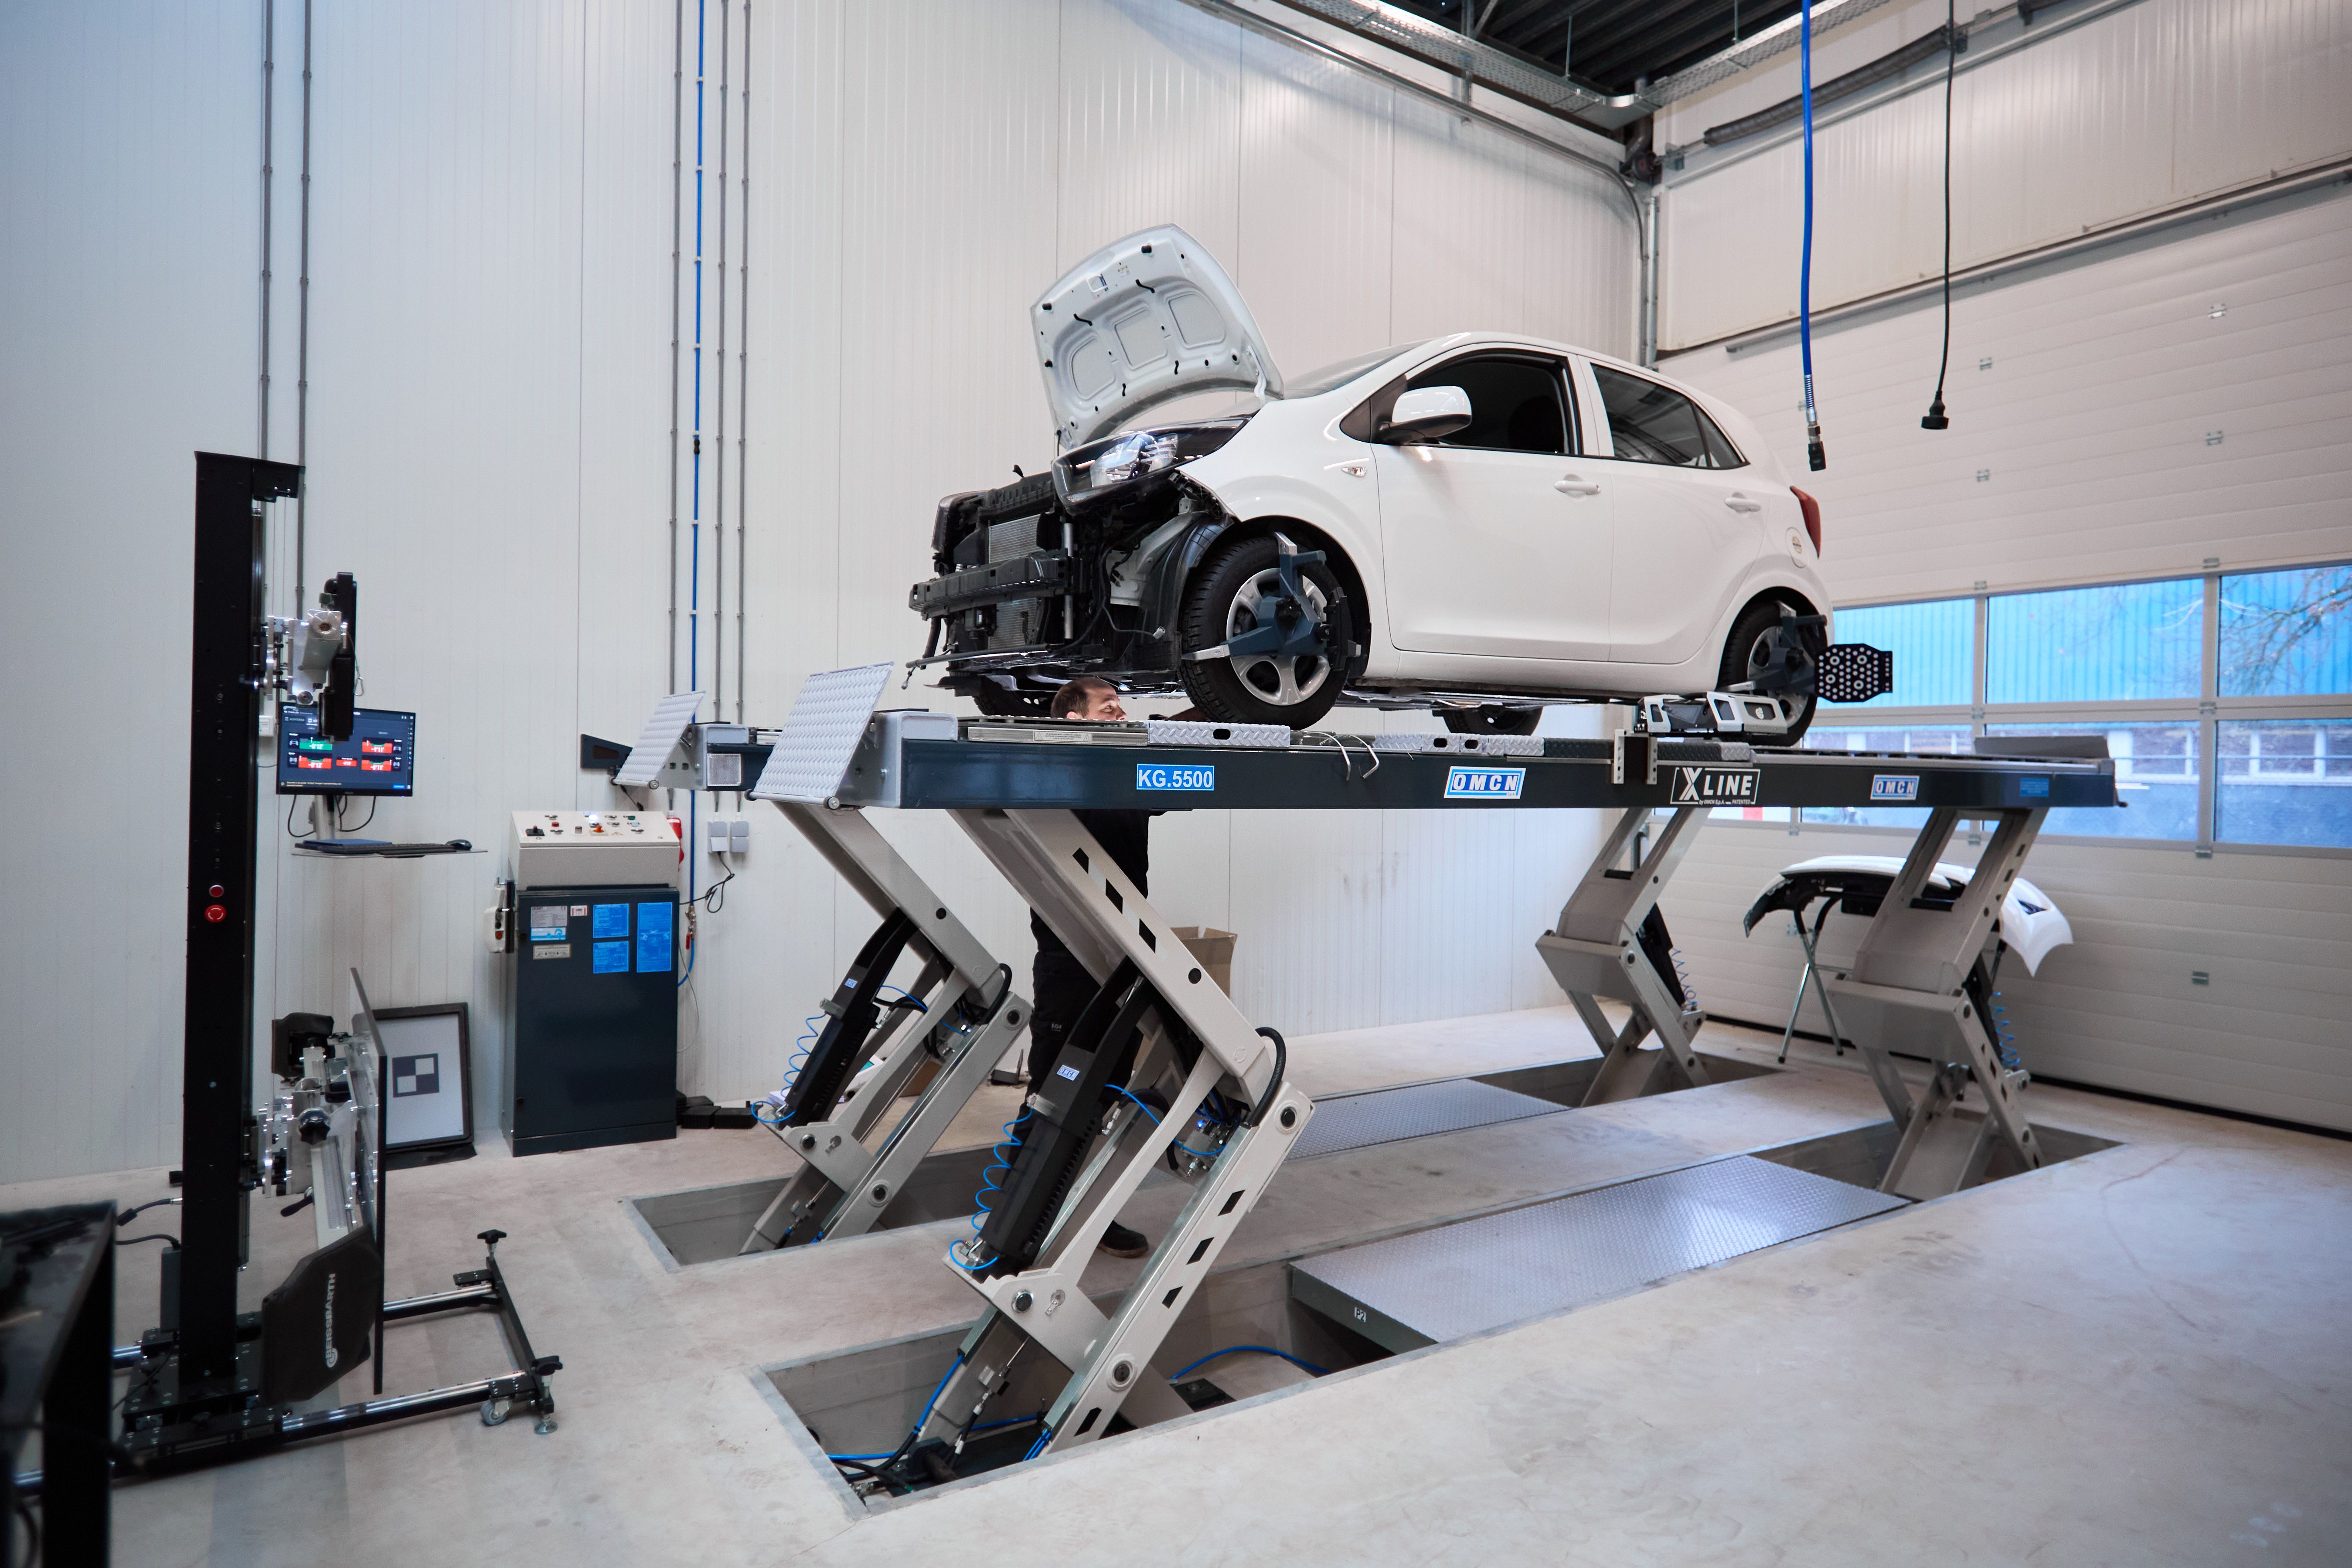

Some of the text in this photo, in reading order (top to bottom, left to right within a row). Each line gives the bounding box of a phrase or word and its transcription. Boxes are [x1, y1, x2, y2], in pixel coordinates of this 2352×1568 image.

[1138, 769, 1213, 788] KG.5500
[1453, 774, 1518, 791] OMCN
[1875, 781, 1915, 793] OMCN
[1059, 1068, 1077, 1078] OMCN
[325, 1273, 337, 1360] BEISSBARTH
[1356, 1309, 1365, 1321] P2
